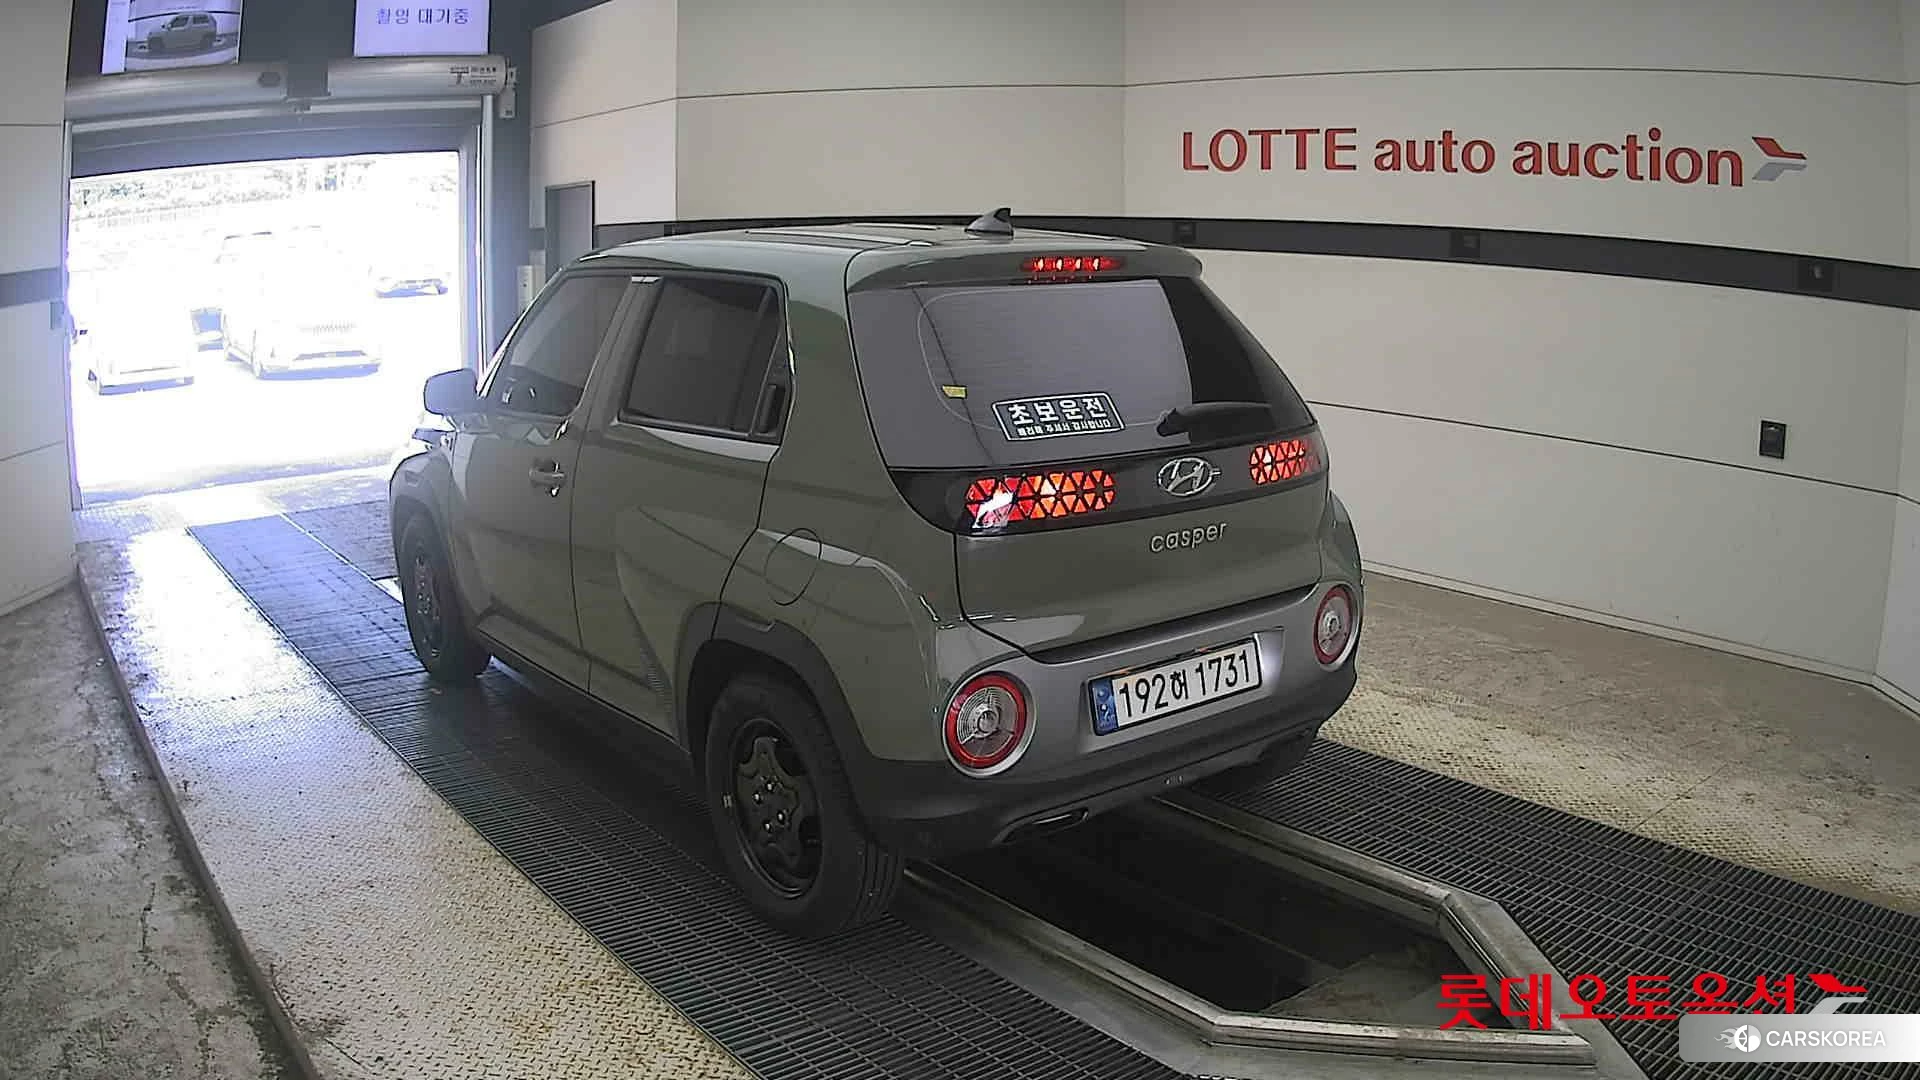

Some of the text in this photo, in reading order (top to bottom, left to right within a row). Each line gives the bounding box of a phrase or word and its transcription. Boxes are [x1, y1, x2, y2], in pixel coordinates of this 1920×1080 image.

[418, 8, 469, 25] 대기중
[1183, 127, 1744, 187] LOTTE auto auction
[1008, 397, 1108, 426] 초보운전
[1151, 522, 1227, 552] casper
